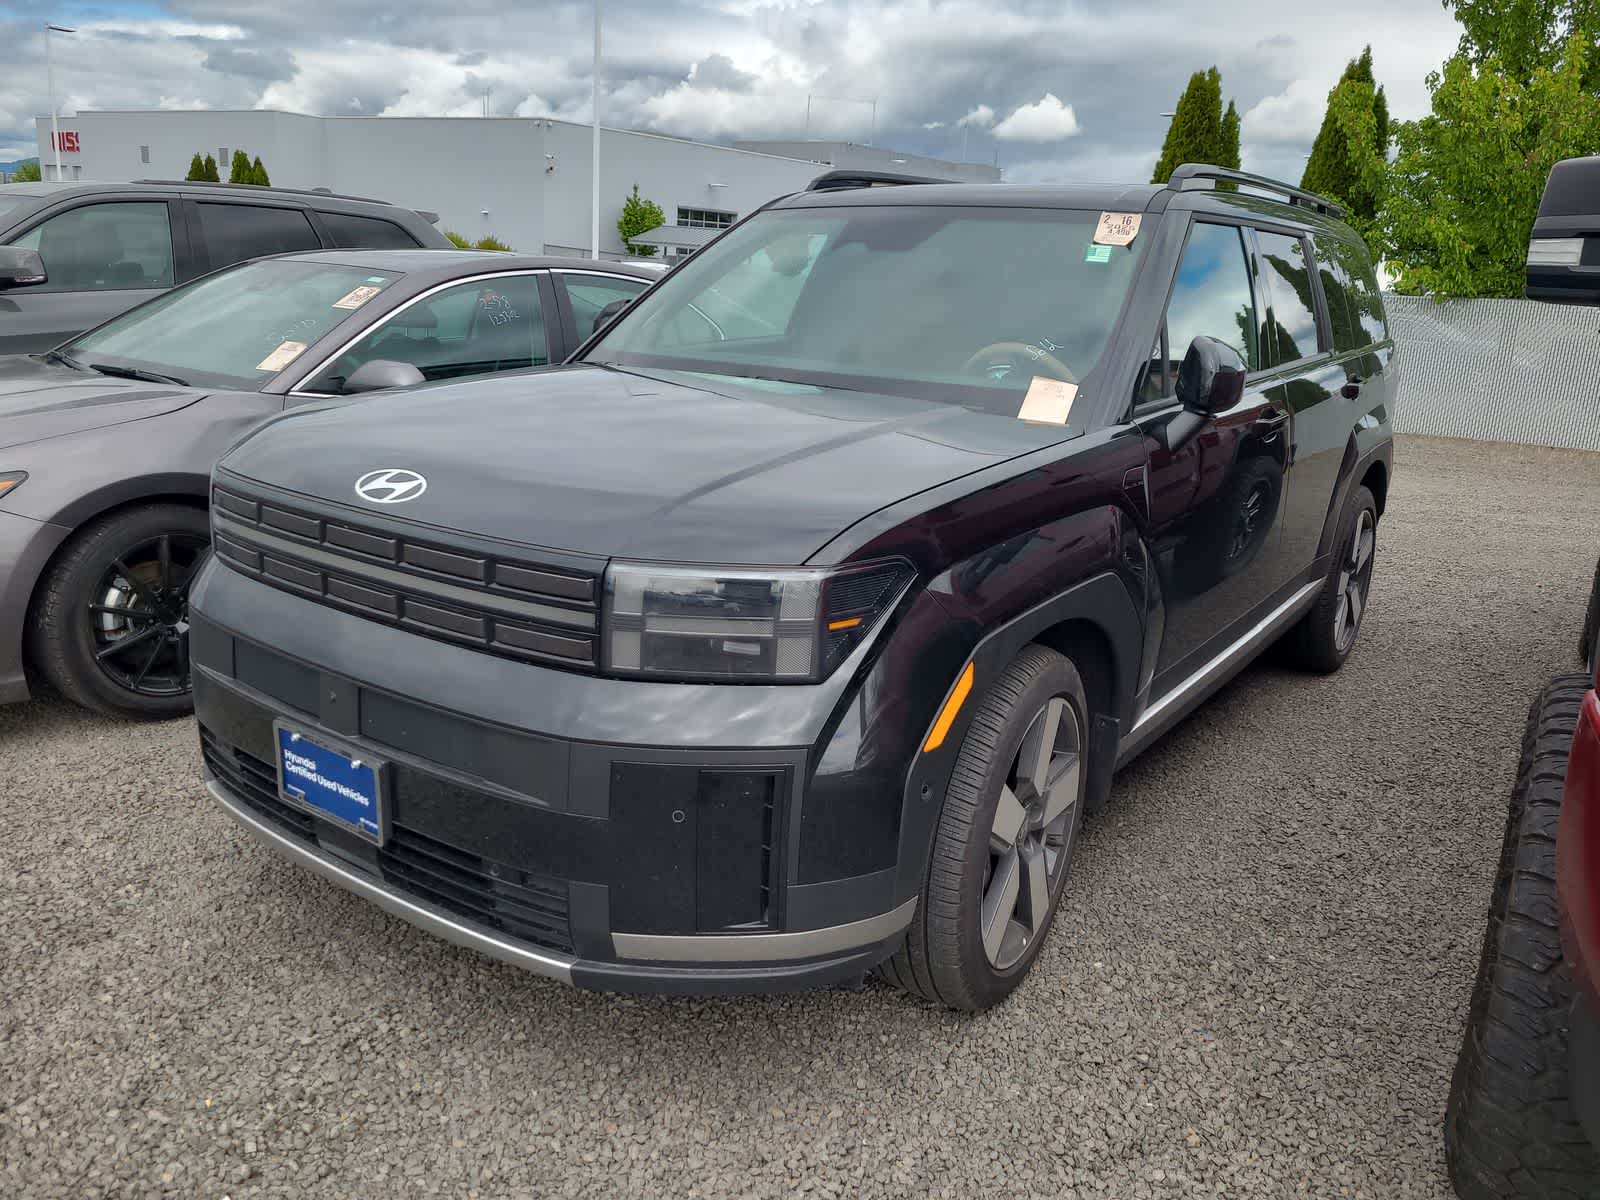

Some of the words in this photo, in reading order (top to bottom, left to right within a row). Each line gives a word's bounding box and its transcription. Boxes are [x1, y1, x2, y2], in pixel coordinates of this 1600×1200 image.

[1122, 216, 1132, 225] 16
[284, 749, 316, 770] Hyundai
[285, 761, 317, 783] Certified
[317, 774, 338, 793] Used
[336, 783, 370, 807] Vehicles
